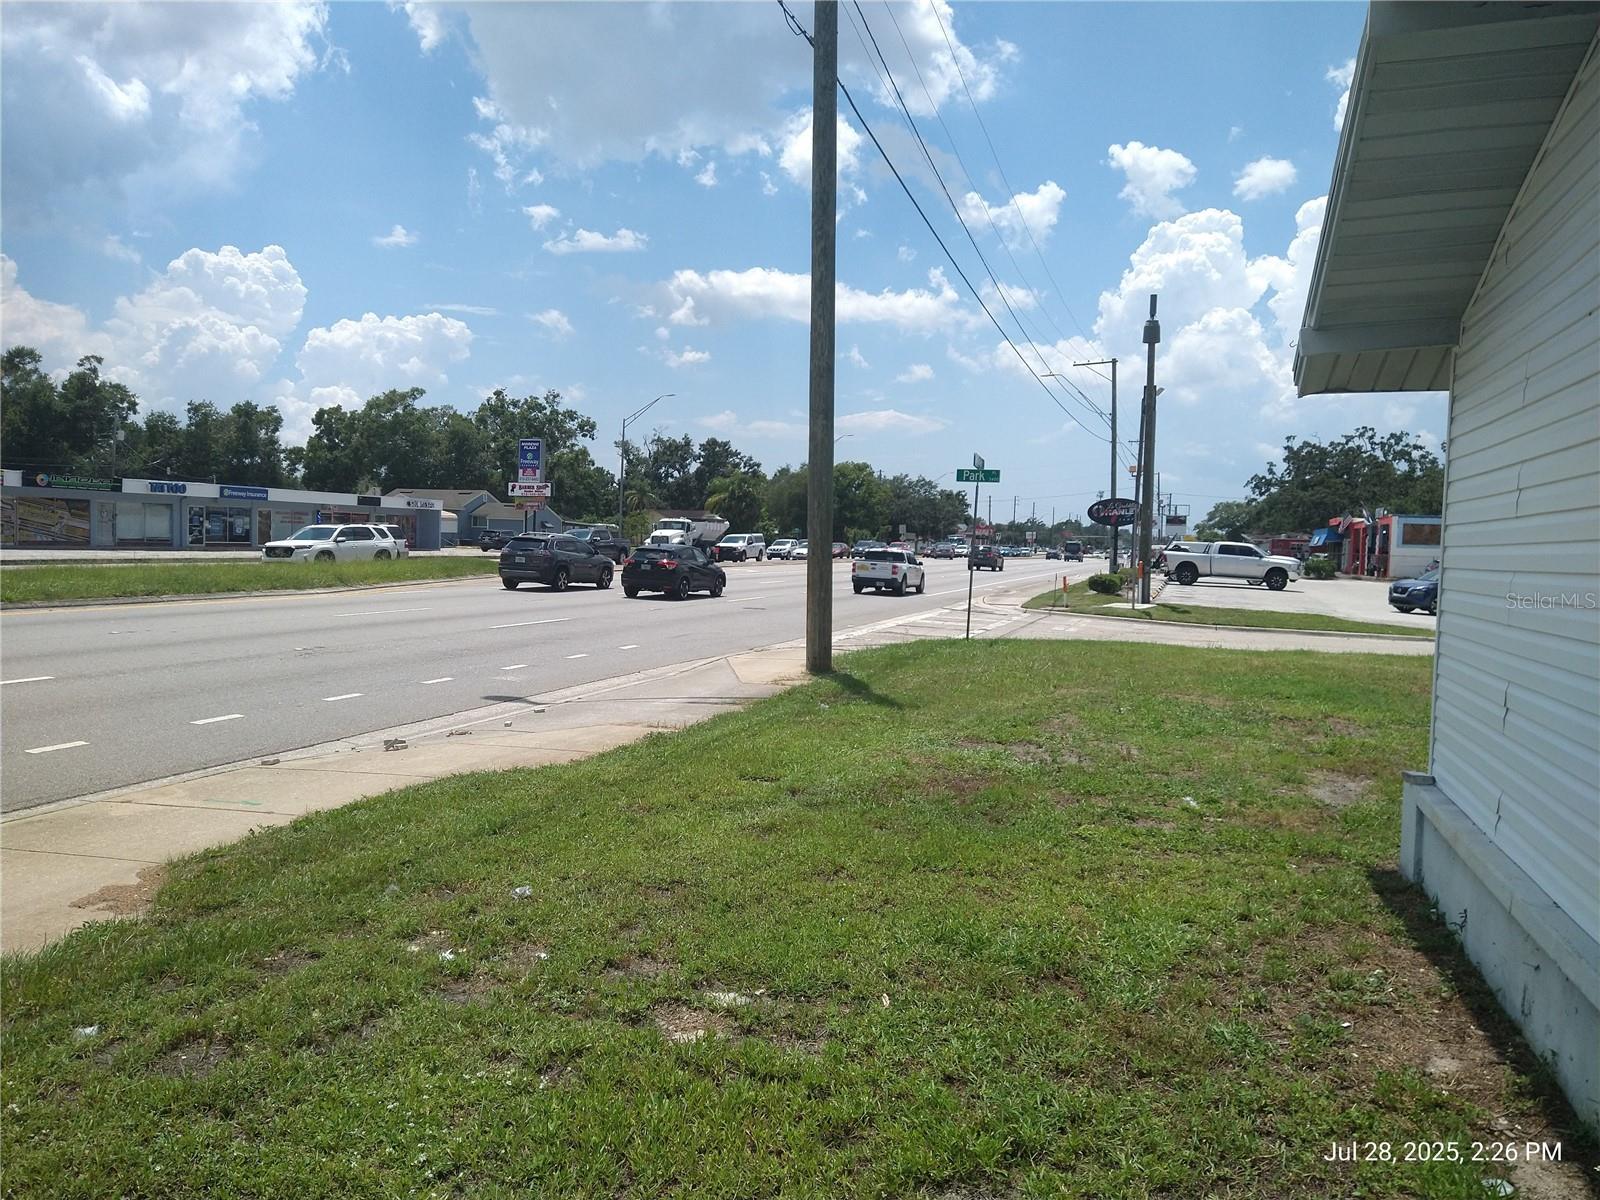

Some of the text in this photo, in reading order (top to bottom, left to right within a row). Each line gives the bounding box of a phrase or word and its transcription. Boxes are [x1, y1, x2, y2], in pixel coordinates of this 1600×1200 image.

[963, 470, 985, 481] Park
[148, 481, 187, 494] TATTOO
[228, 488, 267, 498] Freeway Insurance
